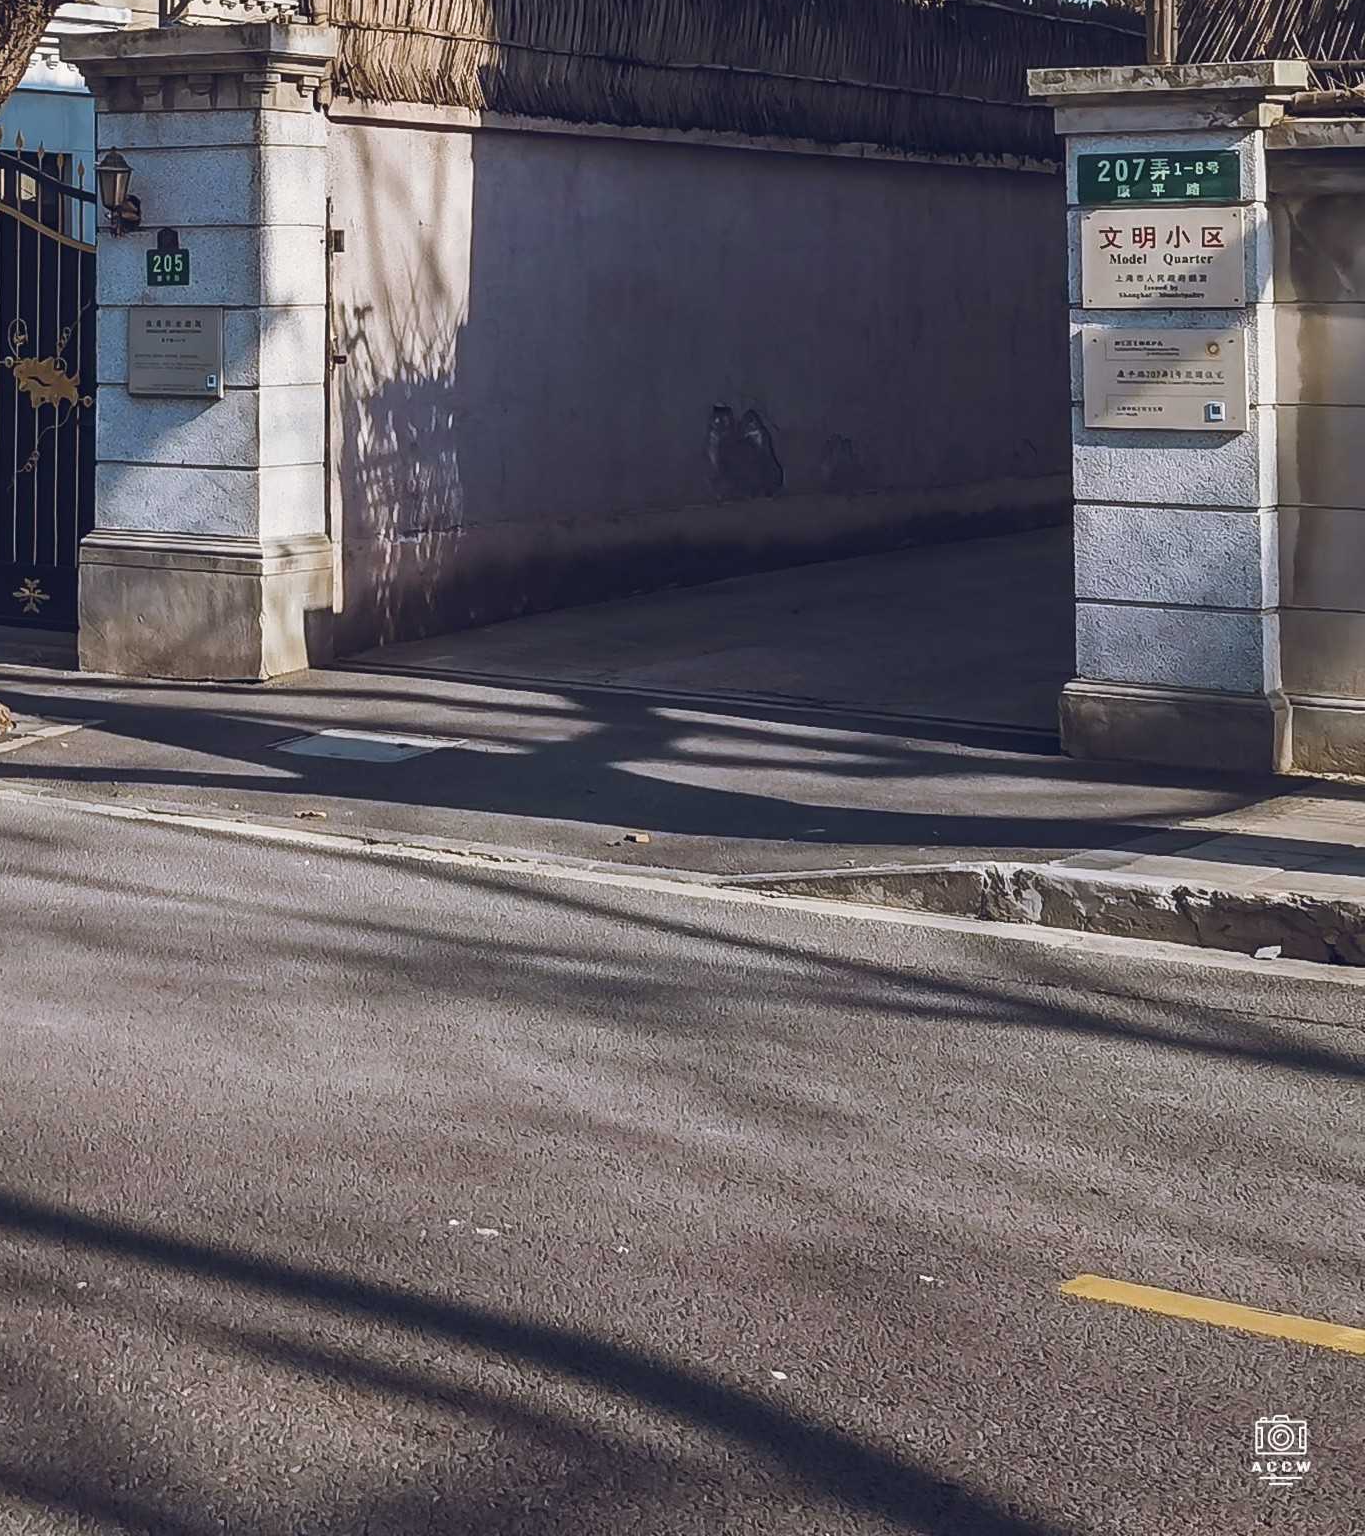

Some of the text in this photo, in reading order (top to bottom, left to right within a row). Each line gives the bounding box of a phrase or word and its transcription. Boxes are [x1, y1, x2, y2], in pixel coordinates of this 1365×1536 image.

[1098, 225, 1225, 250] 文明小区
[153, 254, 183, 273] 205
[1109, 253, 1214, 266] Model Quarter
